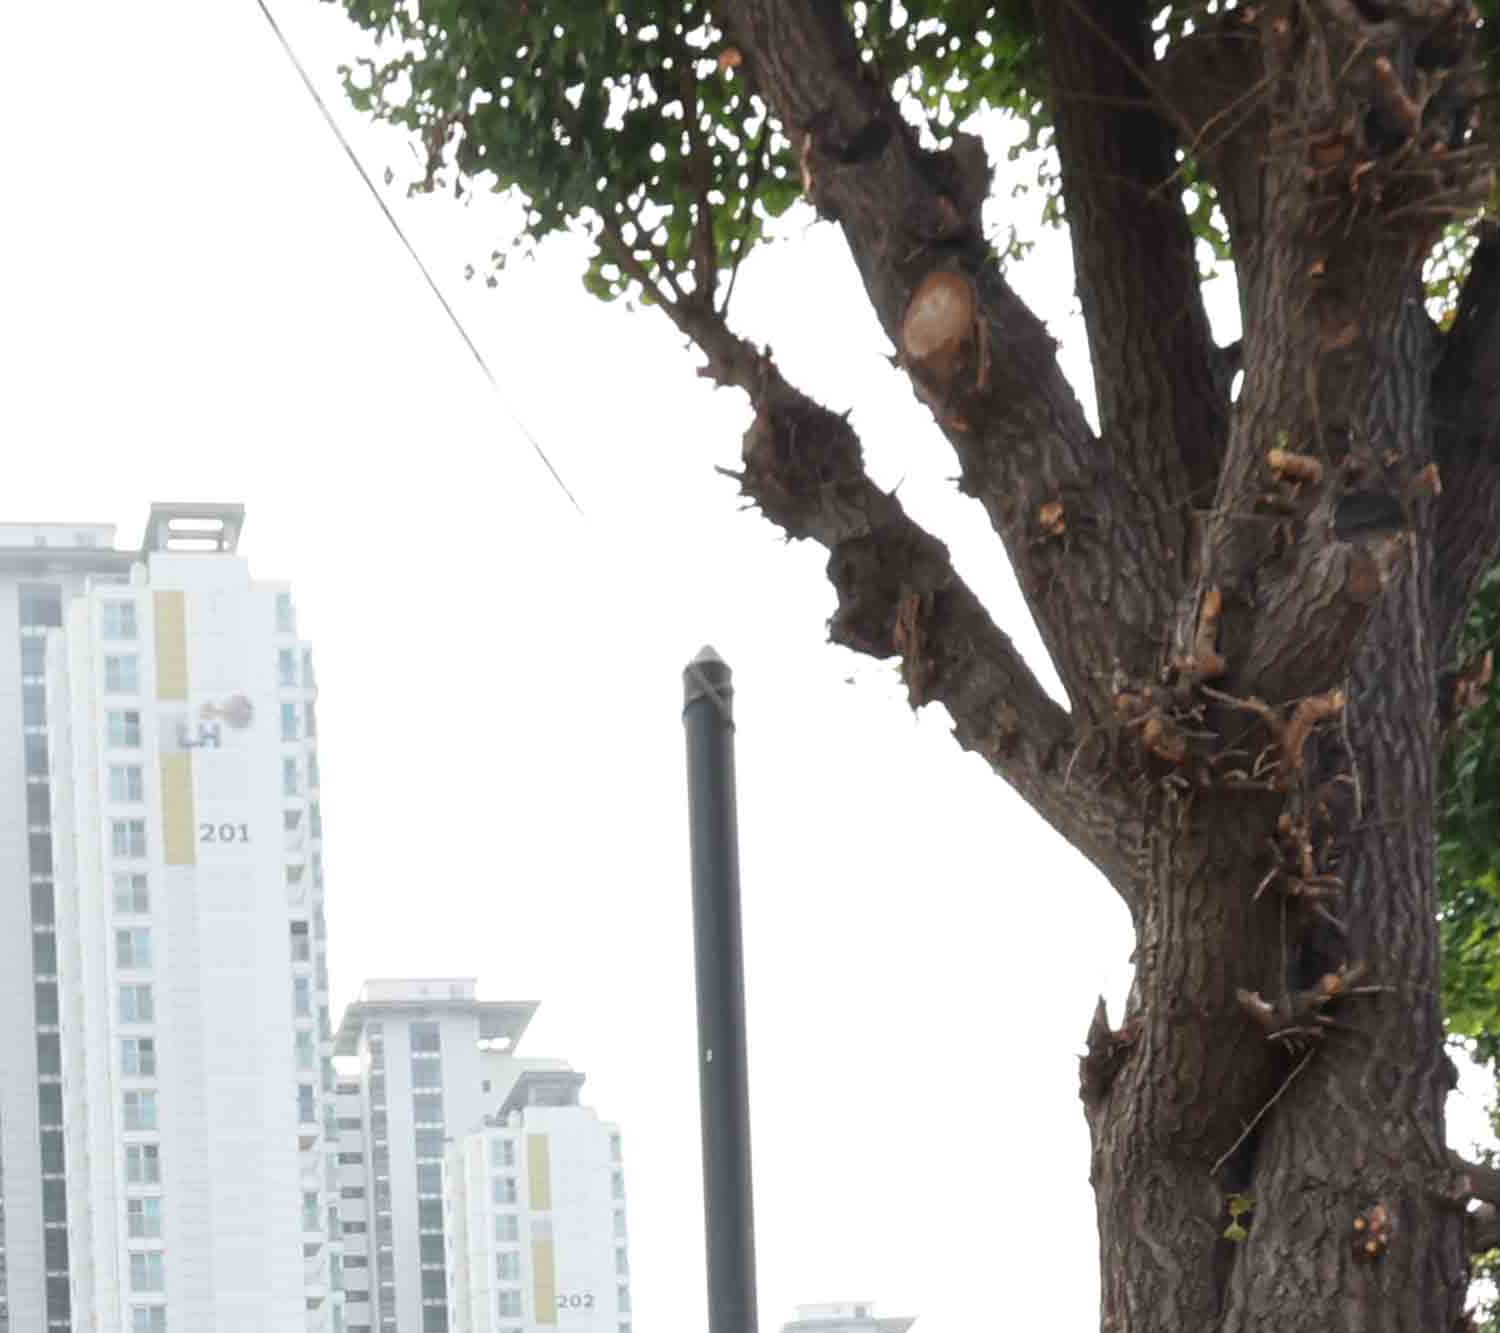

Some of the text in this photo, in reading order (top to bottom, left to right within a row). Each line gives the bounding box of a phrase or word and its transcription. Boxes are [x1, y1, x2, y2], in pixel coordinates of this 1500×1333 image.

[177, 722, 222, 750] LH
[200, 823, 250, 844] 201
[557, 1293, 595, 1308] 202
